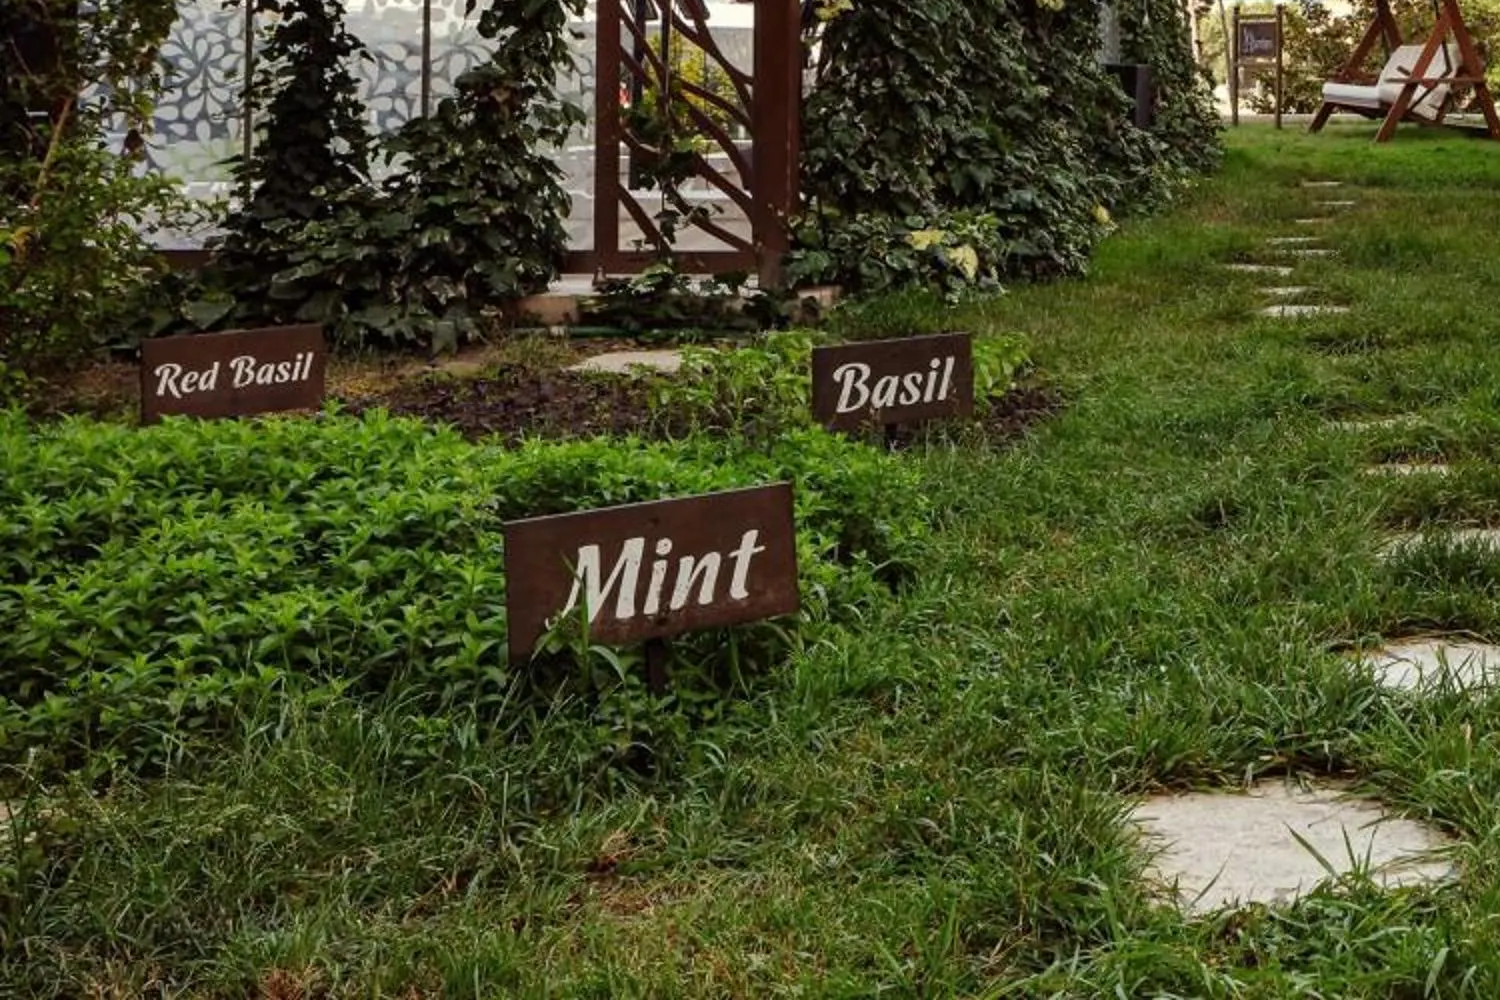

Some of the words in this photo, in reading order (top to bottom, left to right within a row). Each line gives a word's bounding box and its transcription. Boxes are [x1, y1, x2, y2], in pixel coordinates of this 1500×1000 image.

[154, 361, 220, 399] Red
[229, 352, 314, 388] Basil
[832, 356, 955, 414] Basil
[545, 529, 765, 631] Mint
